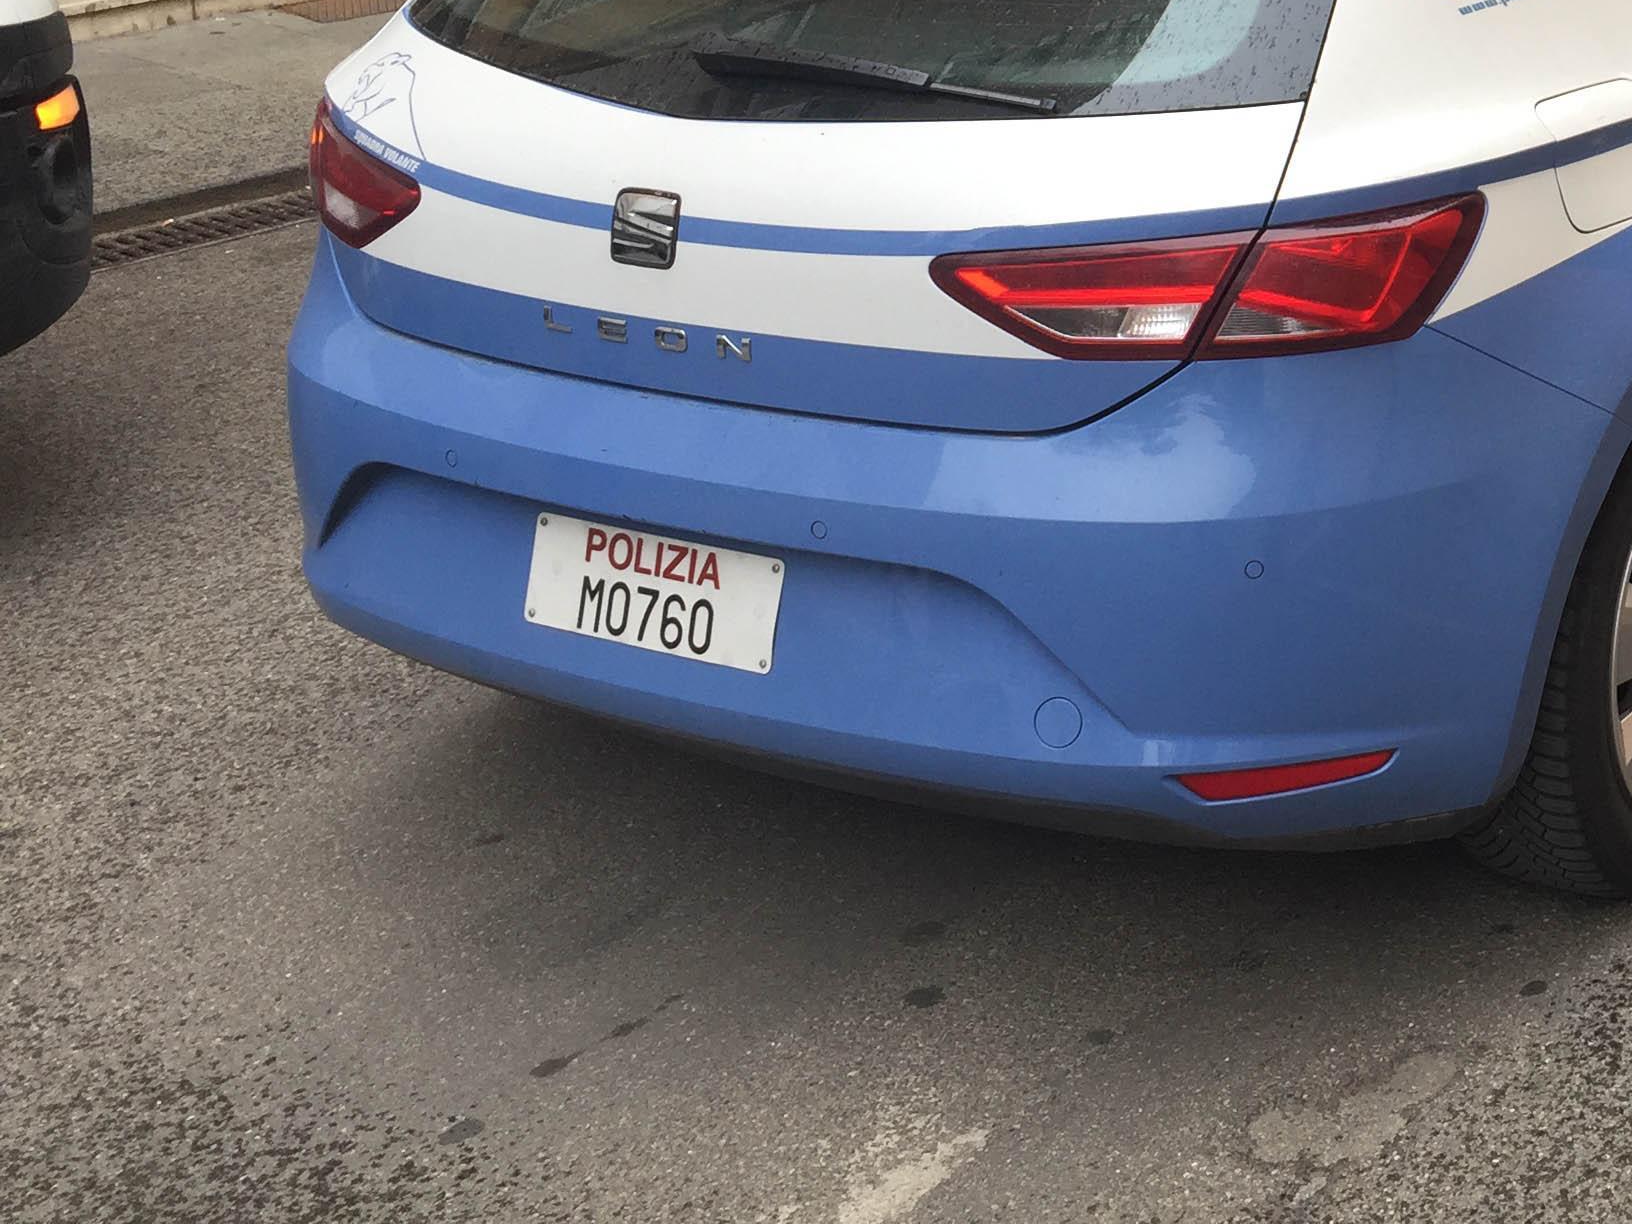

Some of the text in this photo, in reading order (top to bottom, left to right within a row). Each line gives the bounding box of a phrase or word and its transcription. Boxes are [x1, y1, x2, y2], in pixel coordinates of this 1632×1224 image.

[383, 147, 421, 173] VOLANTE
[543, 305, 753, 363] LEON
[585, 527, 721, 590] POLIZIA
[576, 575, 714, 655] M0760
